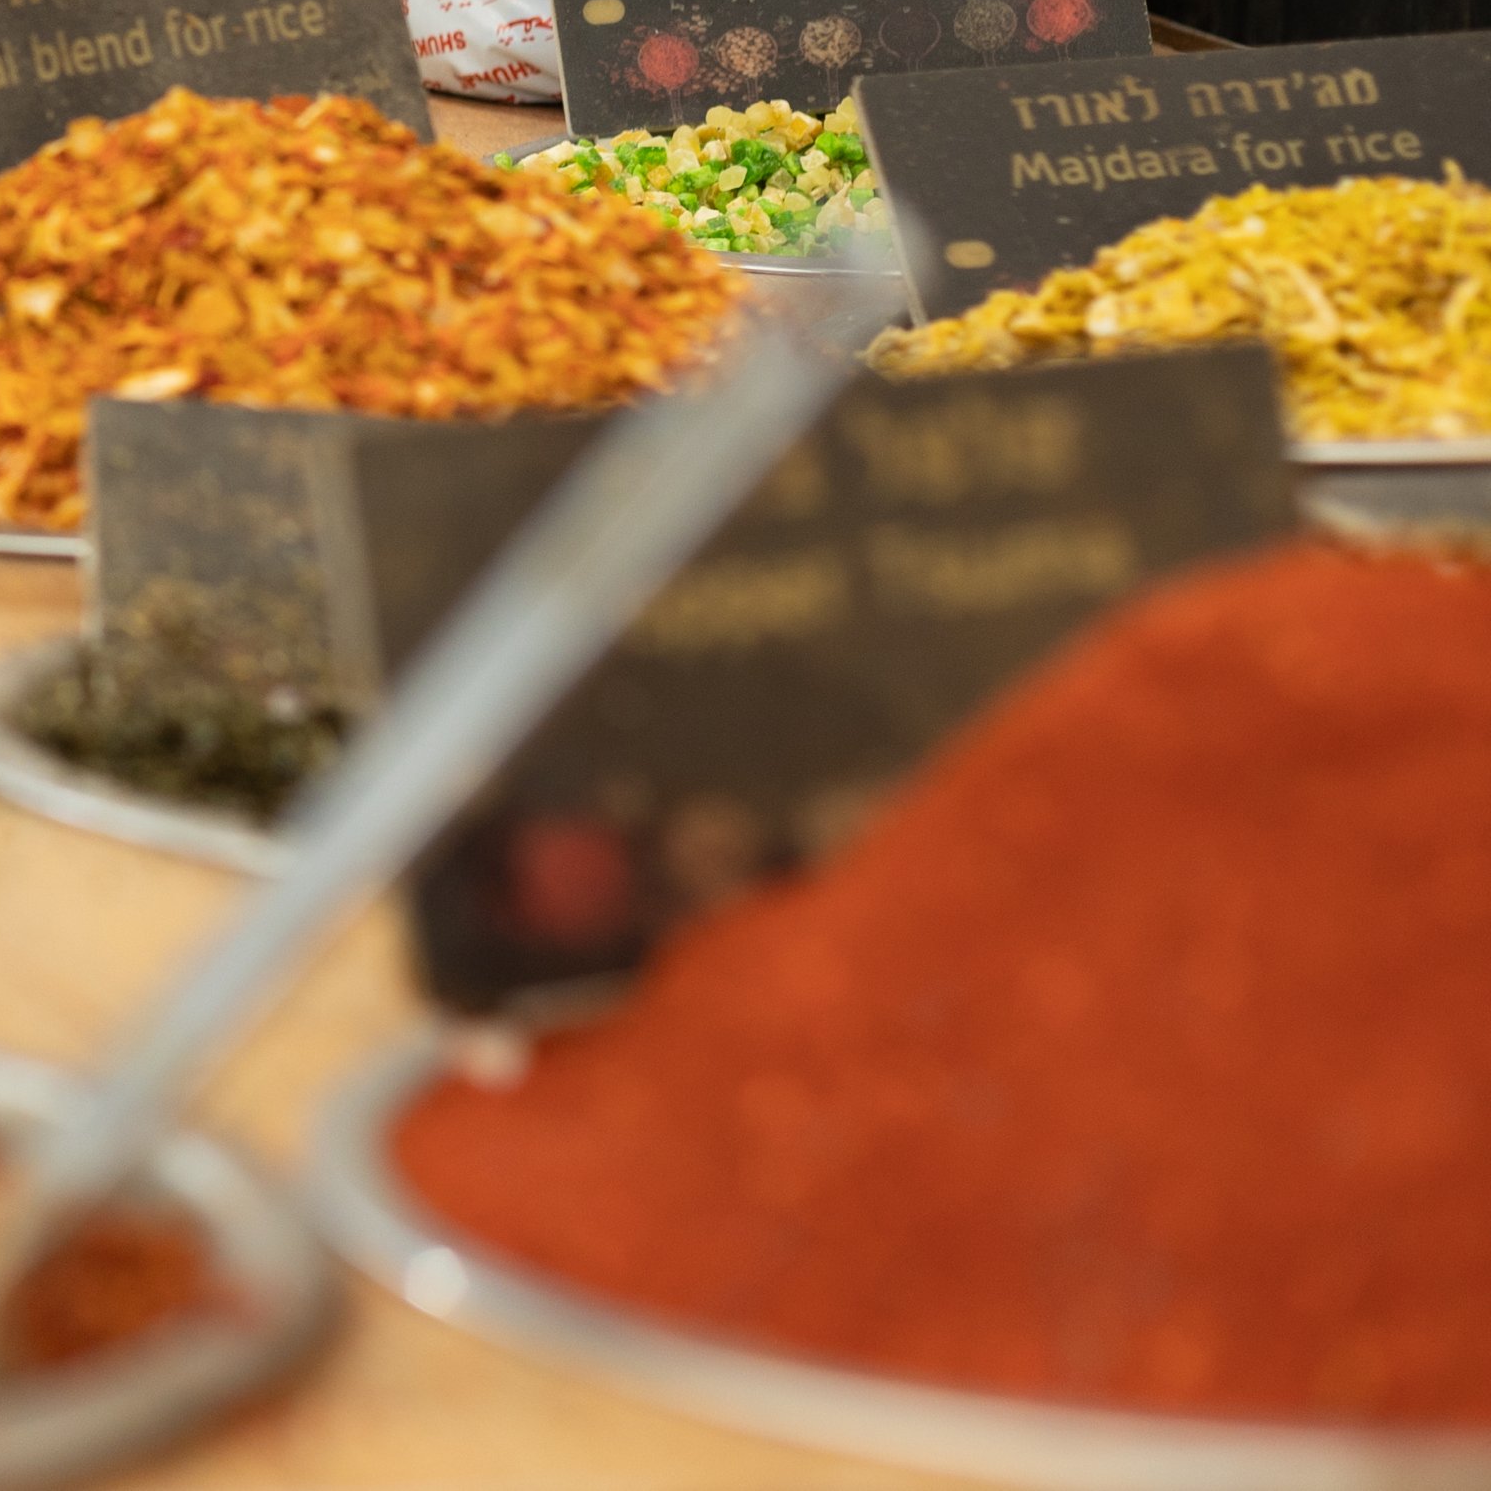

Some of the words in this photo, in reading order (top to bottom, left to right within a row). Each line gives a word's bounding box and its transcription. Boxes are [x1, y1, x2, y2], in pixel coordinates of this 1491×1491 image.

[30, 17, 153, 83] blend
[165, 5, 227, 58] for
[1010, 75, 1161, 131] לאורז
[1009, 143, 1218, 194] Majdara
[1230, 130, 1306, 174] for
[1325, 123, 1423, 169] rice
